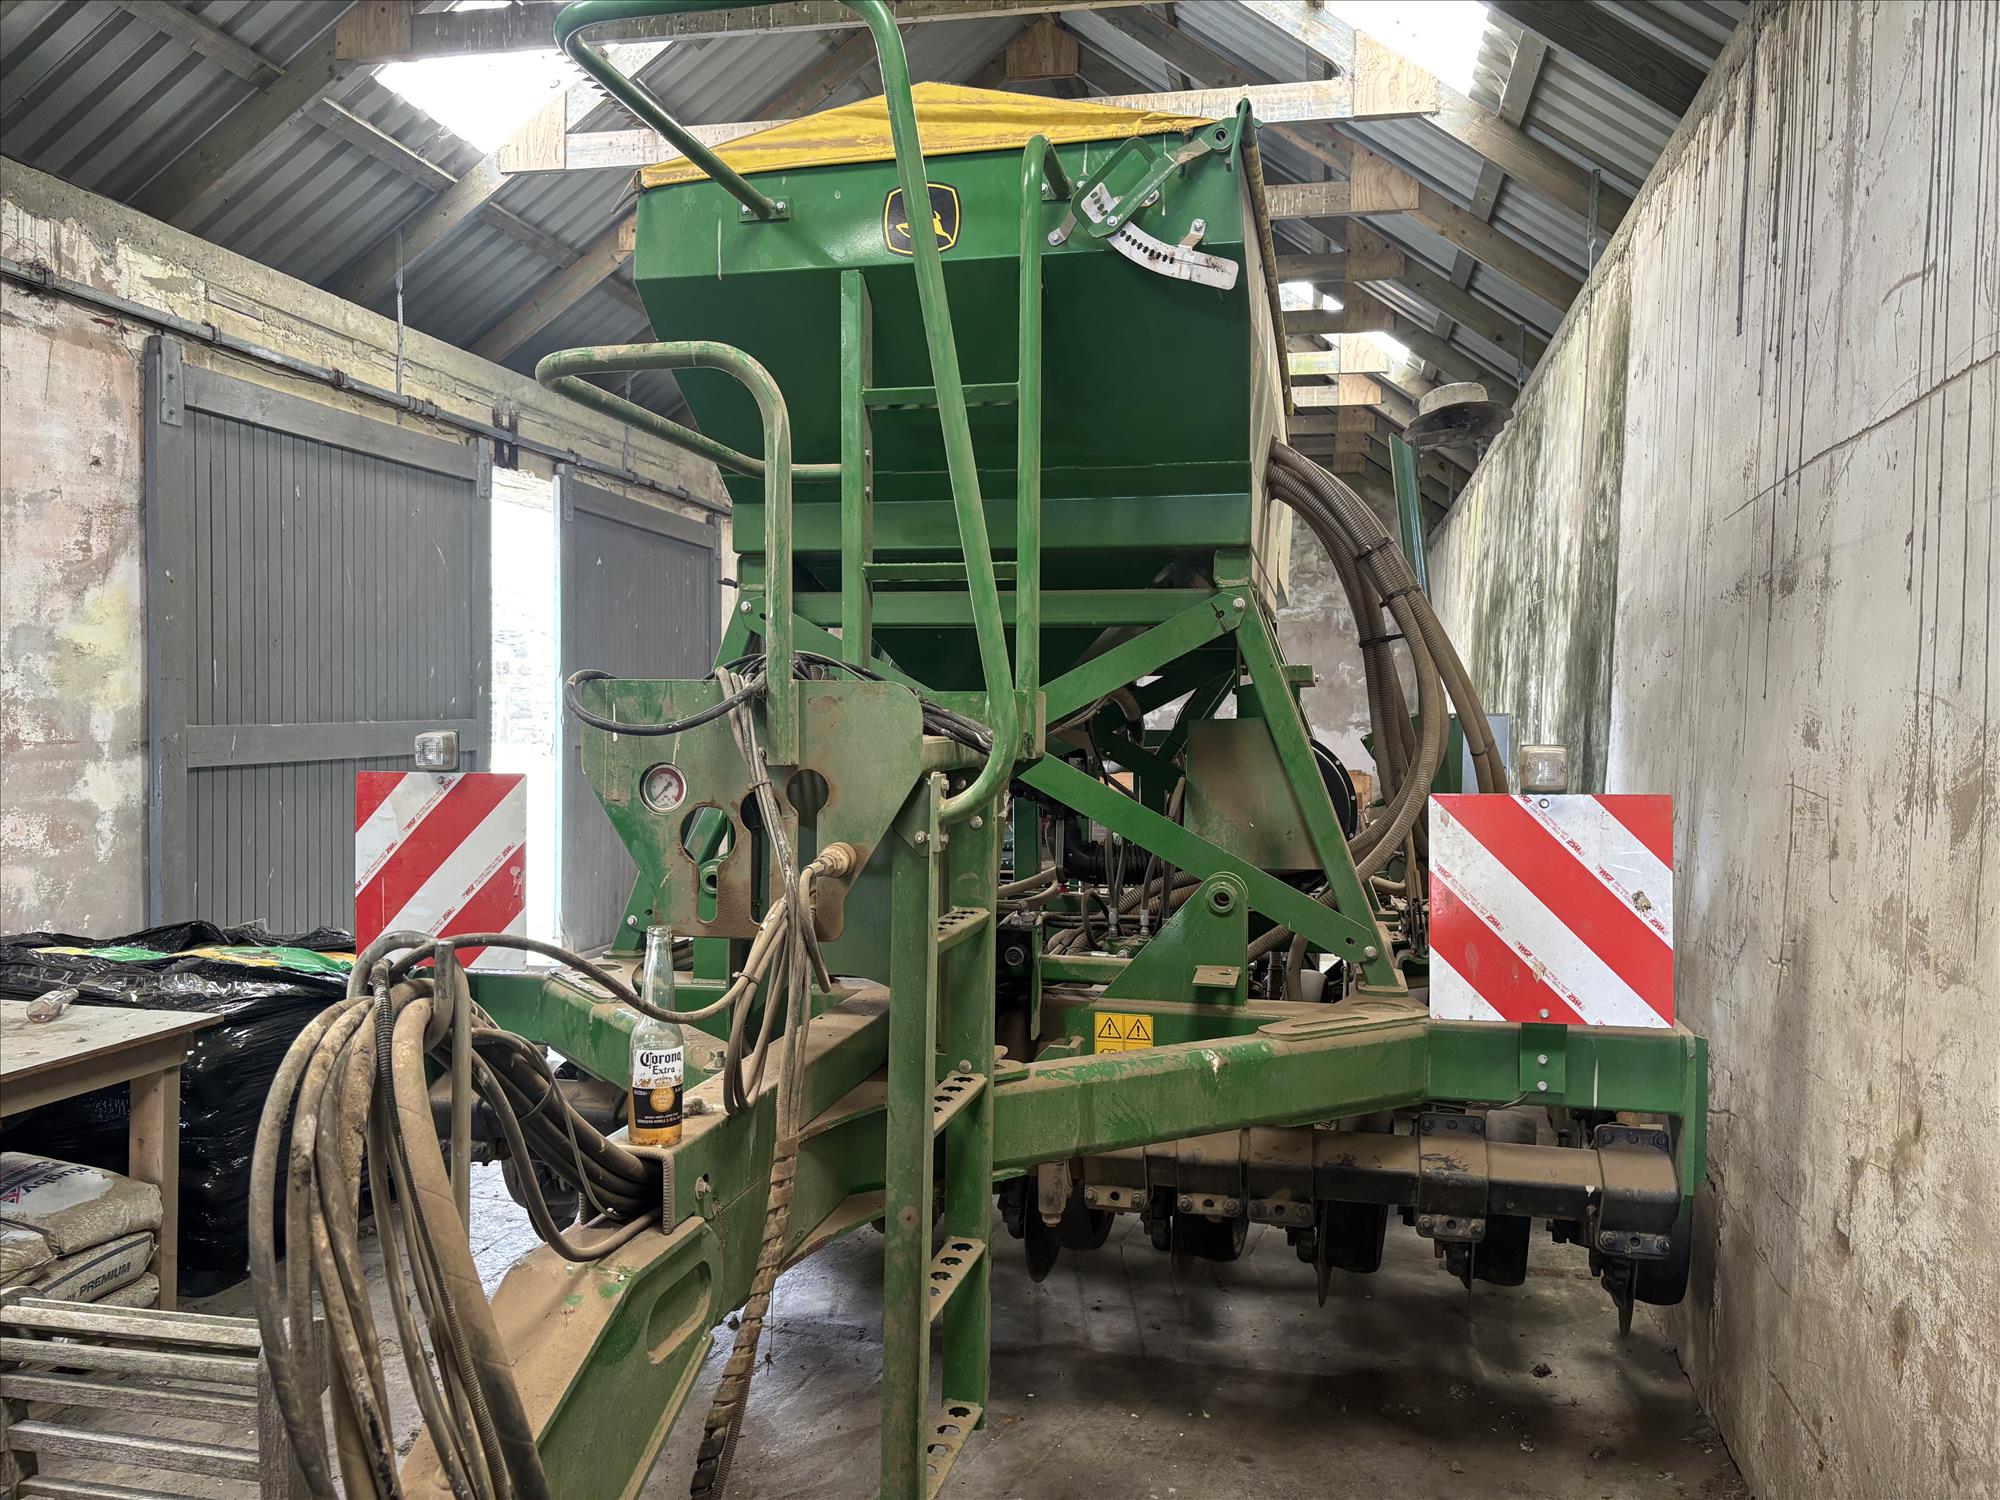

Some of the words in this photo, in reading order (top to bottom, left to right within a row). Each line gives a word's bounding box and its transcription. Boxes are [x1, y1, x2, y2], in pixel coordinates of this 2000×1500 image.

[640, 1051, 682, 1069] Corona
[652, 1065, 676, 1075] Extra
[22, 1166, 91, 1193] Rugby
[79, 1261, 132, 1296] PREMIUM
